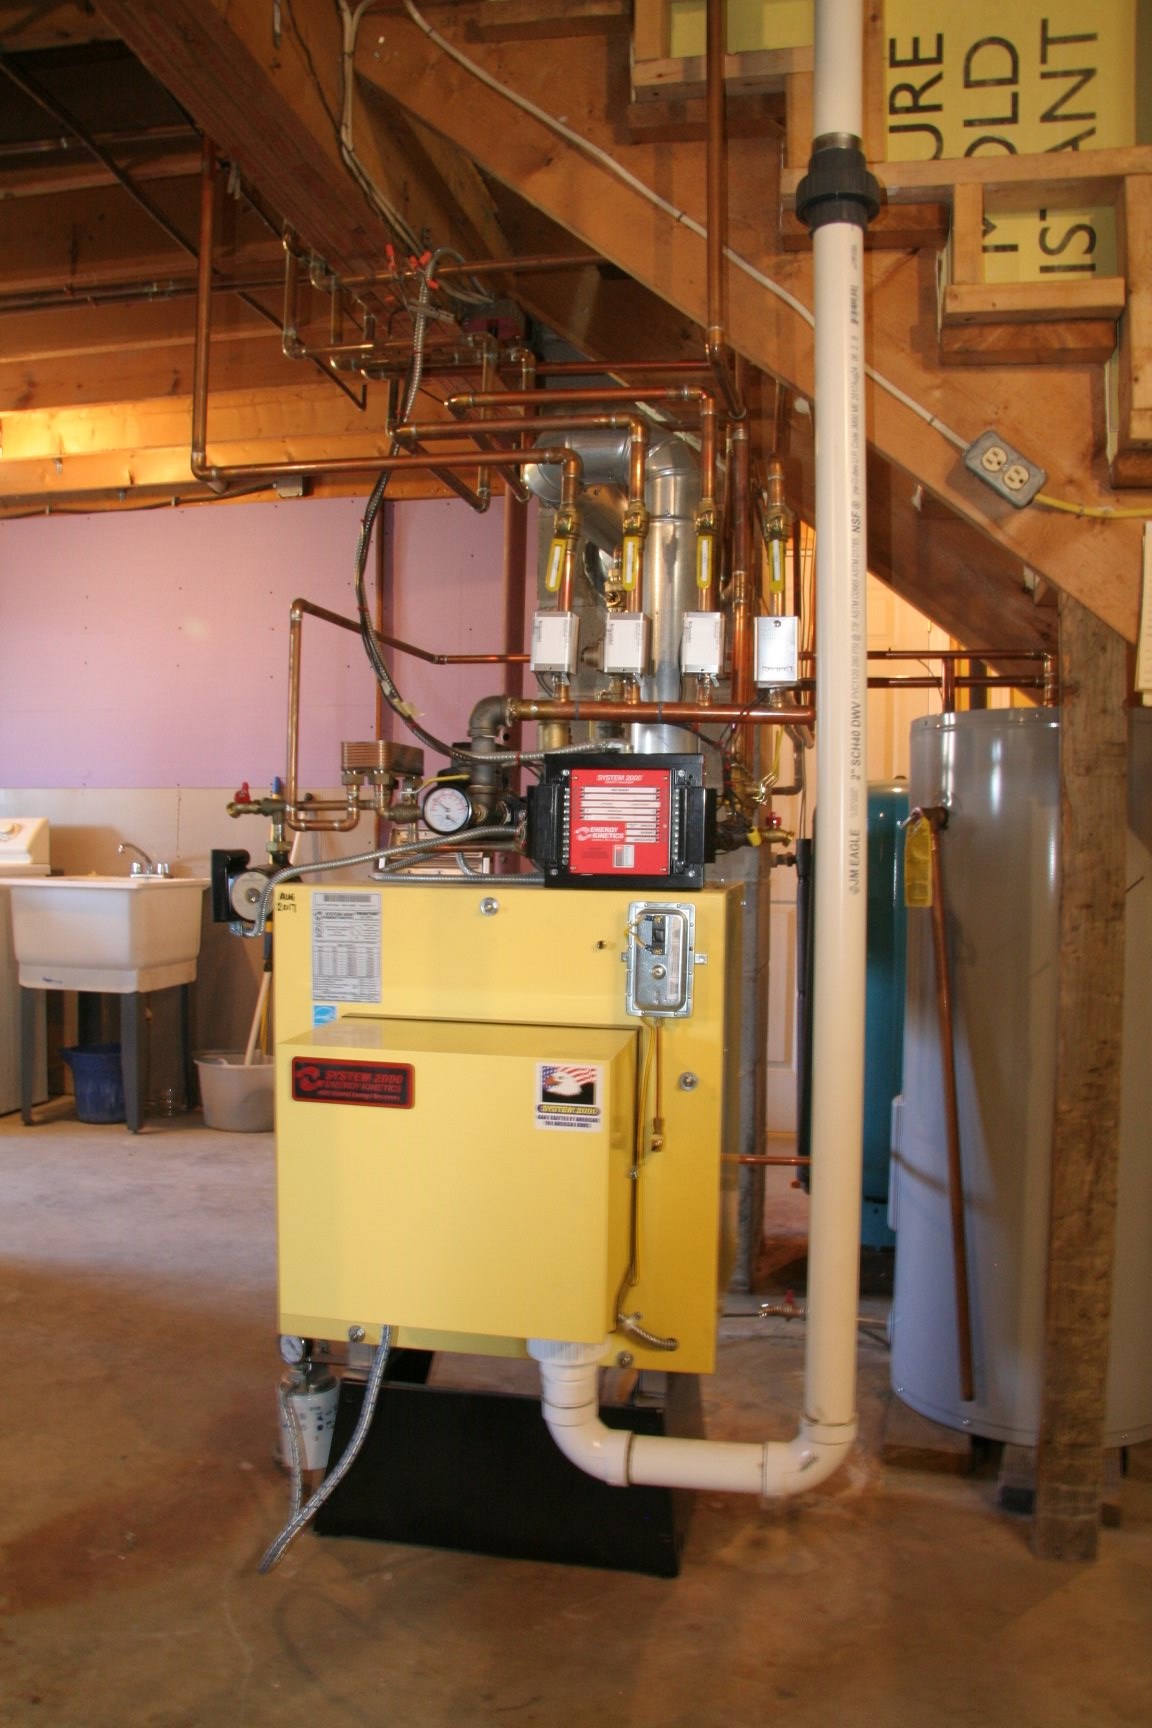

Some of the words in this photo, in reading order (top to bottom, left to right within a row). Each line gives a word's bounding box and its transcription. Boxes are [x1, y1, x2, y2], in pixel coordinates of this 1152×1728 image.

[850, 511, 862, 534] NSF
[850, 702, 862, 728] DWV
[849, 731, 862, 766] SCH40
[597, 774, 625, 782] SYSTEM
[625, 774, 644, 782] 2000
[592, 832, 625, 840] KINETICS
[848, 829, 861, 866] EAGLE
[326, 1070, 372, 1082] SYSTEM
[374, 1073, 403, 1084] 2000
[361, 1083, 402, 1093] KINETICS
